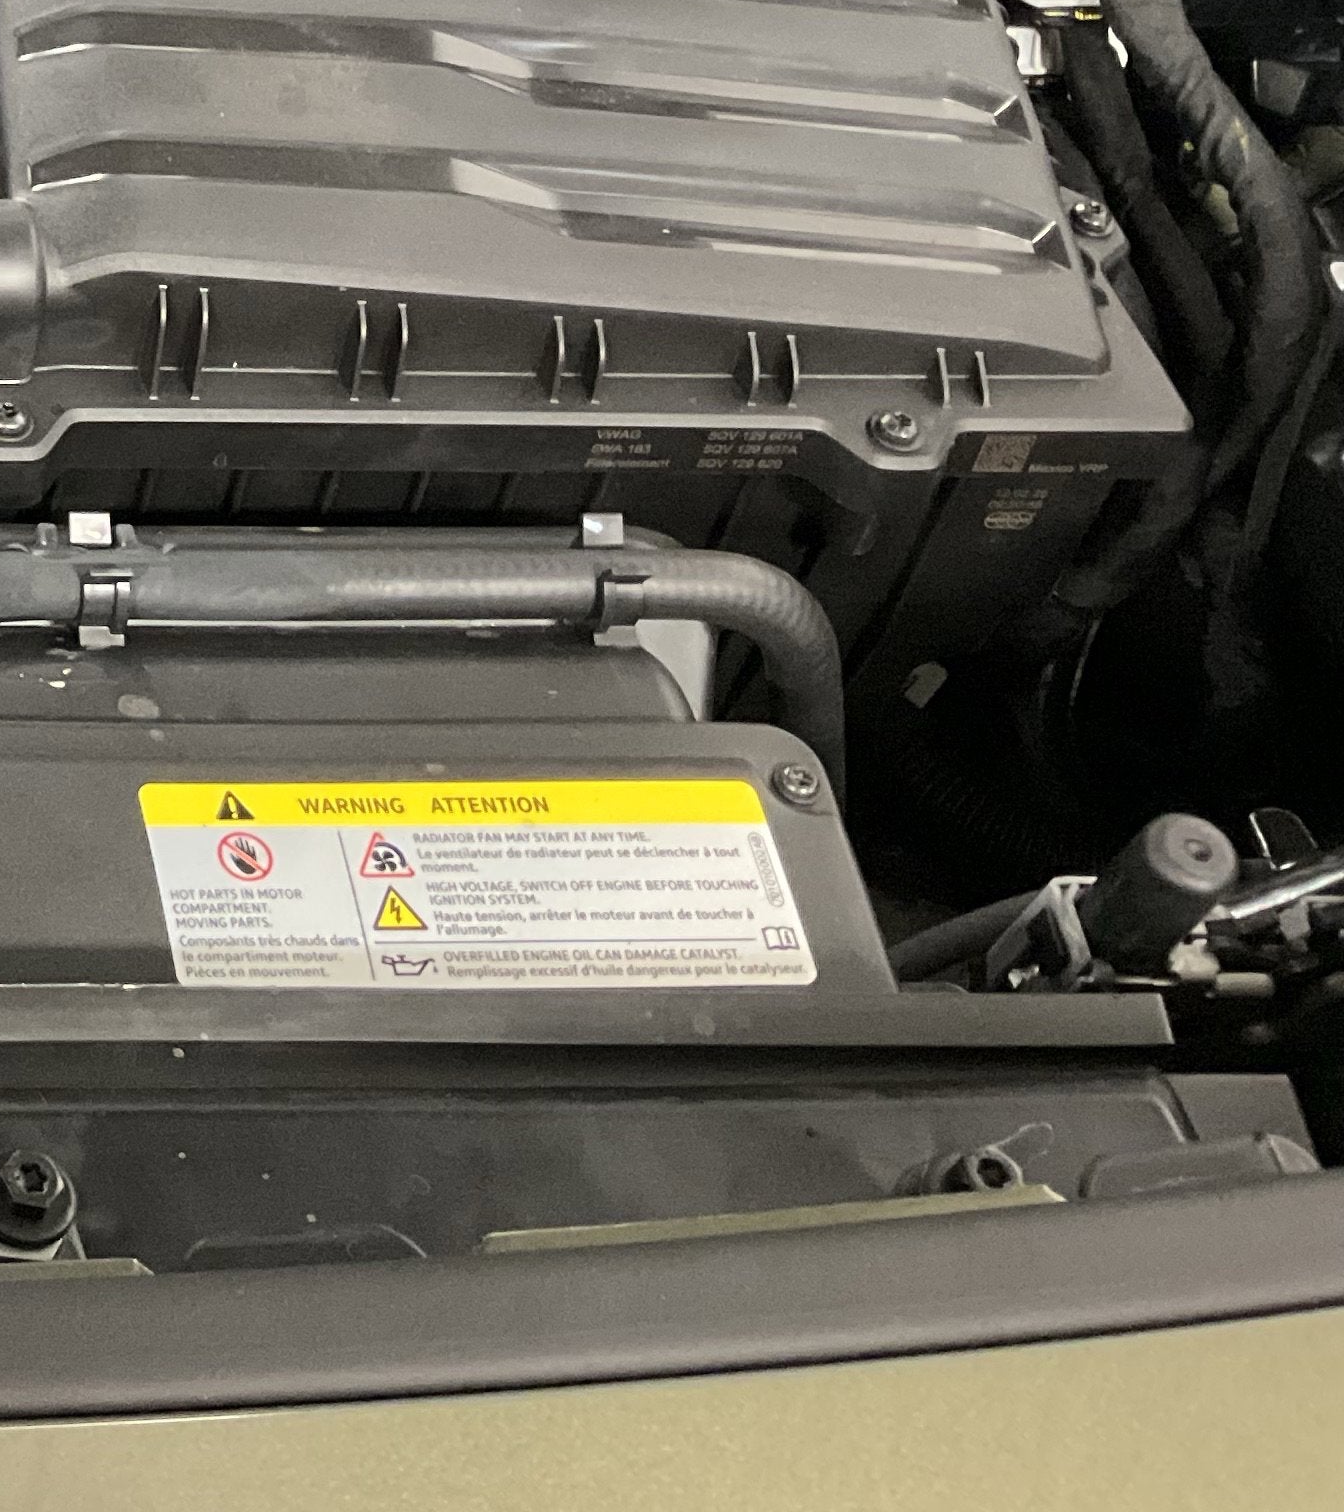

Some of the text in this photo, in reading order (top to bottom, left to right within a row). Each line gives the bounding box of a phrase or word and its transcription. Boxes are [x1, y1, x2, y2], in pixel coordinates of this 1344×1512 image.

[298, 796, 550, 814] WARNING ATTENTION
[413, 832, 651, 843] RADIATOR FAN MAY START AT ANY TIME.
[418, 846, 741, 859] Le ventilateur de radiateur peut se déclencher à tout
[421, 863, 479, 873] moment.
[426, 882, 457, 892] HIGH
[519, 881, 567, 892] SWITCH
[570, 880, 593, 891] OFF
[597, 880, 642, 891] ENGINE
[646, 880, 692, 891] BEFORE
[696, 880, 759, 891] TOUCHING
[170, 889, 303, 900] HOT PARTS IN MOTOR
[430, 894, 540, 905] IGNITION SYSTEM.
[172, 903, 271, 914] COMPARTMENT.
[434, 908, 755, 923] Haute tension, arrêter le moteur avant de toucher à
[176, 917, 274, 929] MOVING PARTS.
[437, 924, 507, 937] l'allumage.
[259, 936, 281, 946] très
[284, 934, 328, 946] chauds
[331, 934, 360, 946] dans
[182, 950, 343, 964] le compartiment moteur.
[443, 948, 742, 962] OVERFILLED ENGINE OIL CAN DAMAGE CATALYST.
[186, 966, 330, 977] Pièces en mouvement.
[447, 963, 808, 979] Remplissage excessif d'huile dangereux pour le catalyseur.
